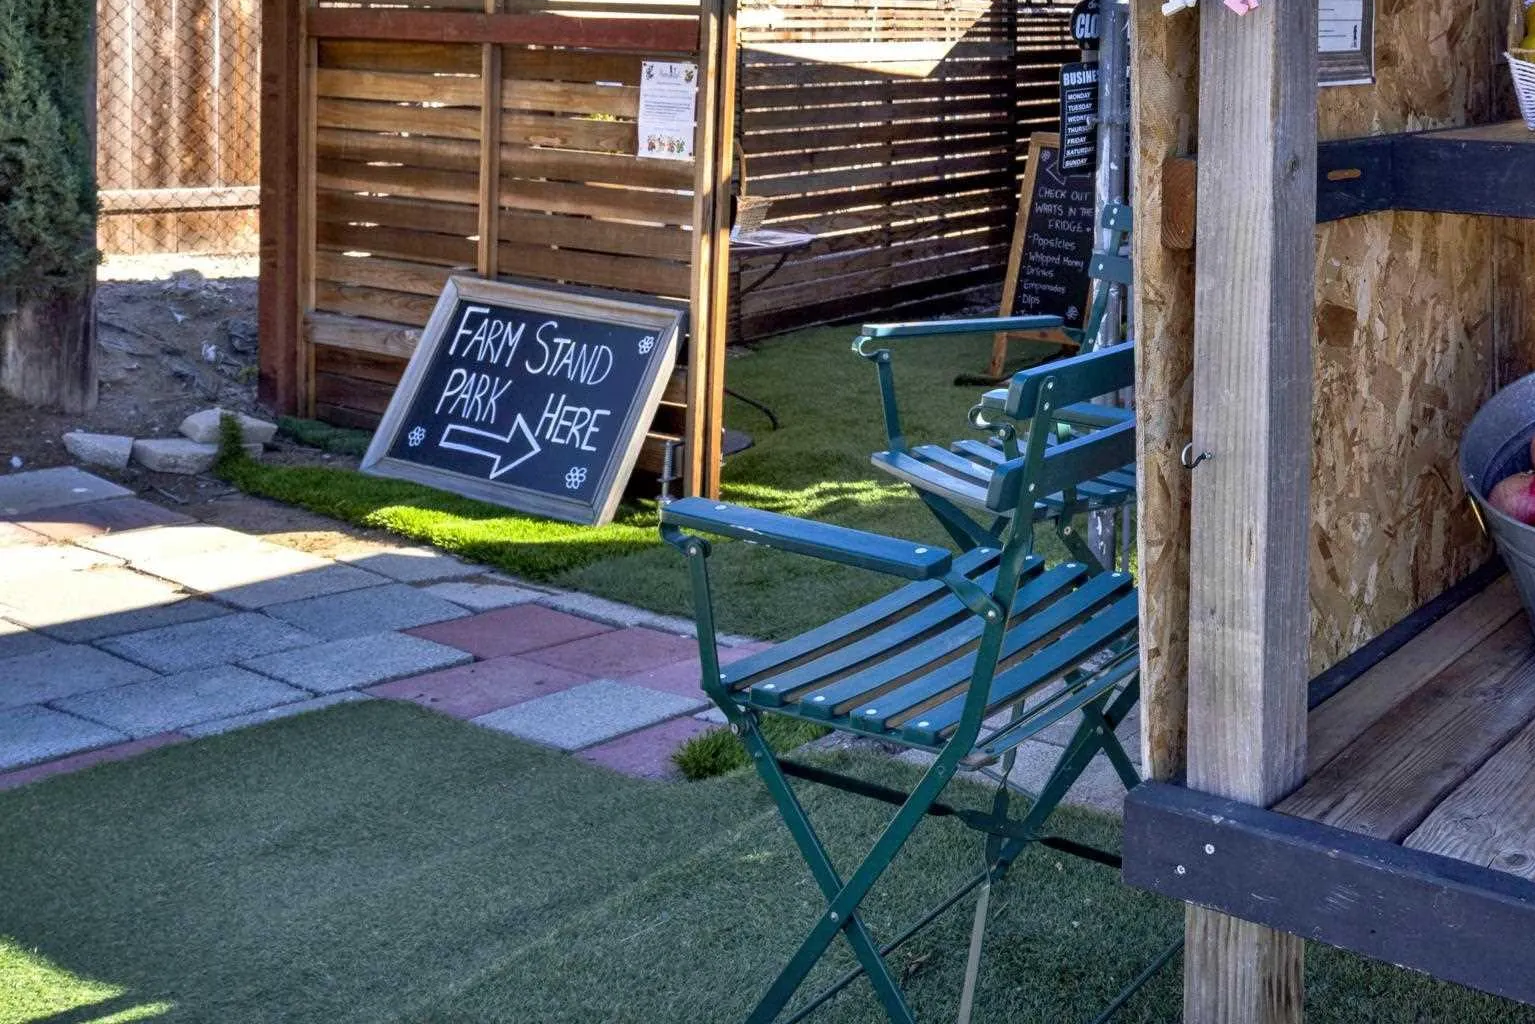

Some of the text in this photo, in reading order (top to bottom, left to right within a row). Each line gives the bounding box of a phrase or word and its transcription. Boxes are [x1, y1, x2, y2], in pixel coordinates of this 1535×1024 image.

[1075, 12, 1100, 40] CLO
[1062, 69, 1098, 87] BUSINE
[1067, 92, 1092, 100] MONDAY
[1067, 103, 1093, 112] TUESDAY
[1066, 136, 1088, 145] FRIDAY
[1066, 146, 1095, 156] SATURDAY
[1065, 158, 1089, 168] SUNDAY
[1038, 186, 1090, 201] CHECK OUT
[1068, 206, 1077, 216] IN
[1080, 208, 1094, 217] THE
[1048, 218, 1083, 233] FRIDGE
[1063, 257, 1084, 272] Honey
[448, 306, 614, 385] FARM STAND
[435, 368, 611, 452] PARK HERE
